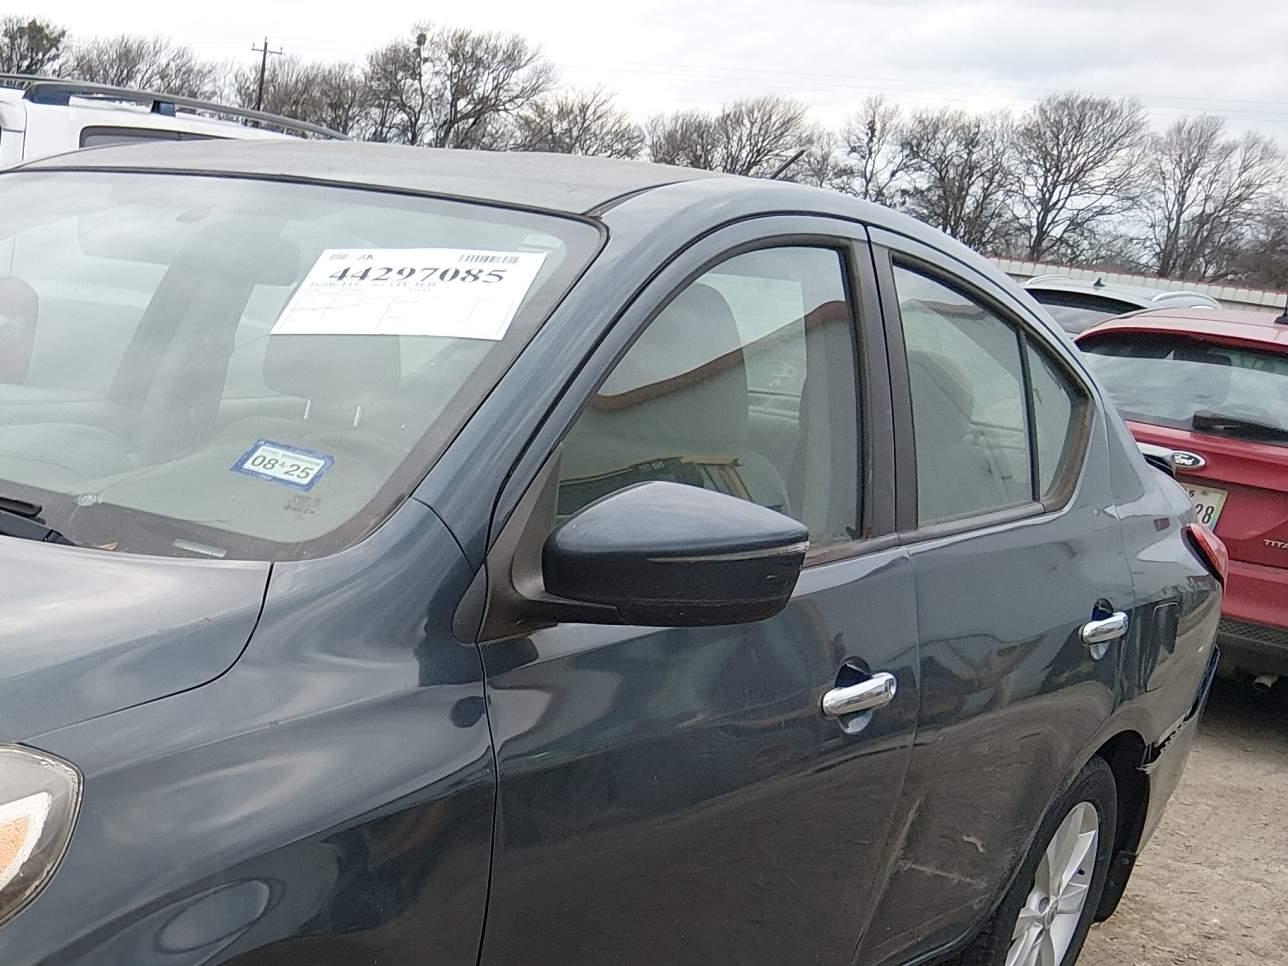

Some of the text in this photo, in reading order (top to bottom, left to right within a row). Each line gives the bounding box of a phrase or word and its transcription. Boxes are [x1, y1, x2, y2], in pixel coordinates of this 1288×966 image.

[329, 267, 507, 284] 44297085
[251, 455, 315, 480] 08 25
